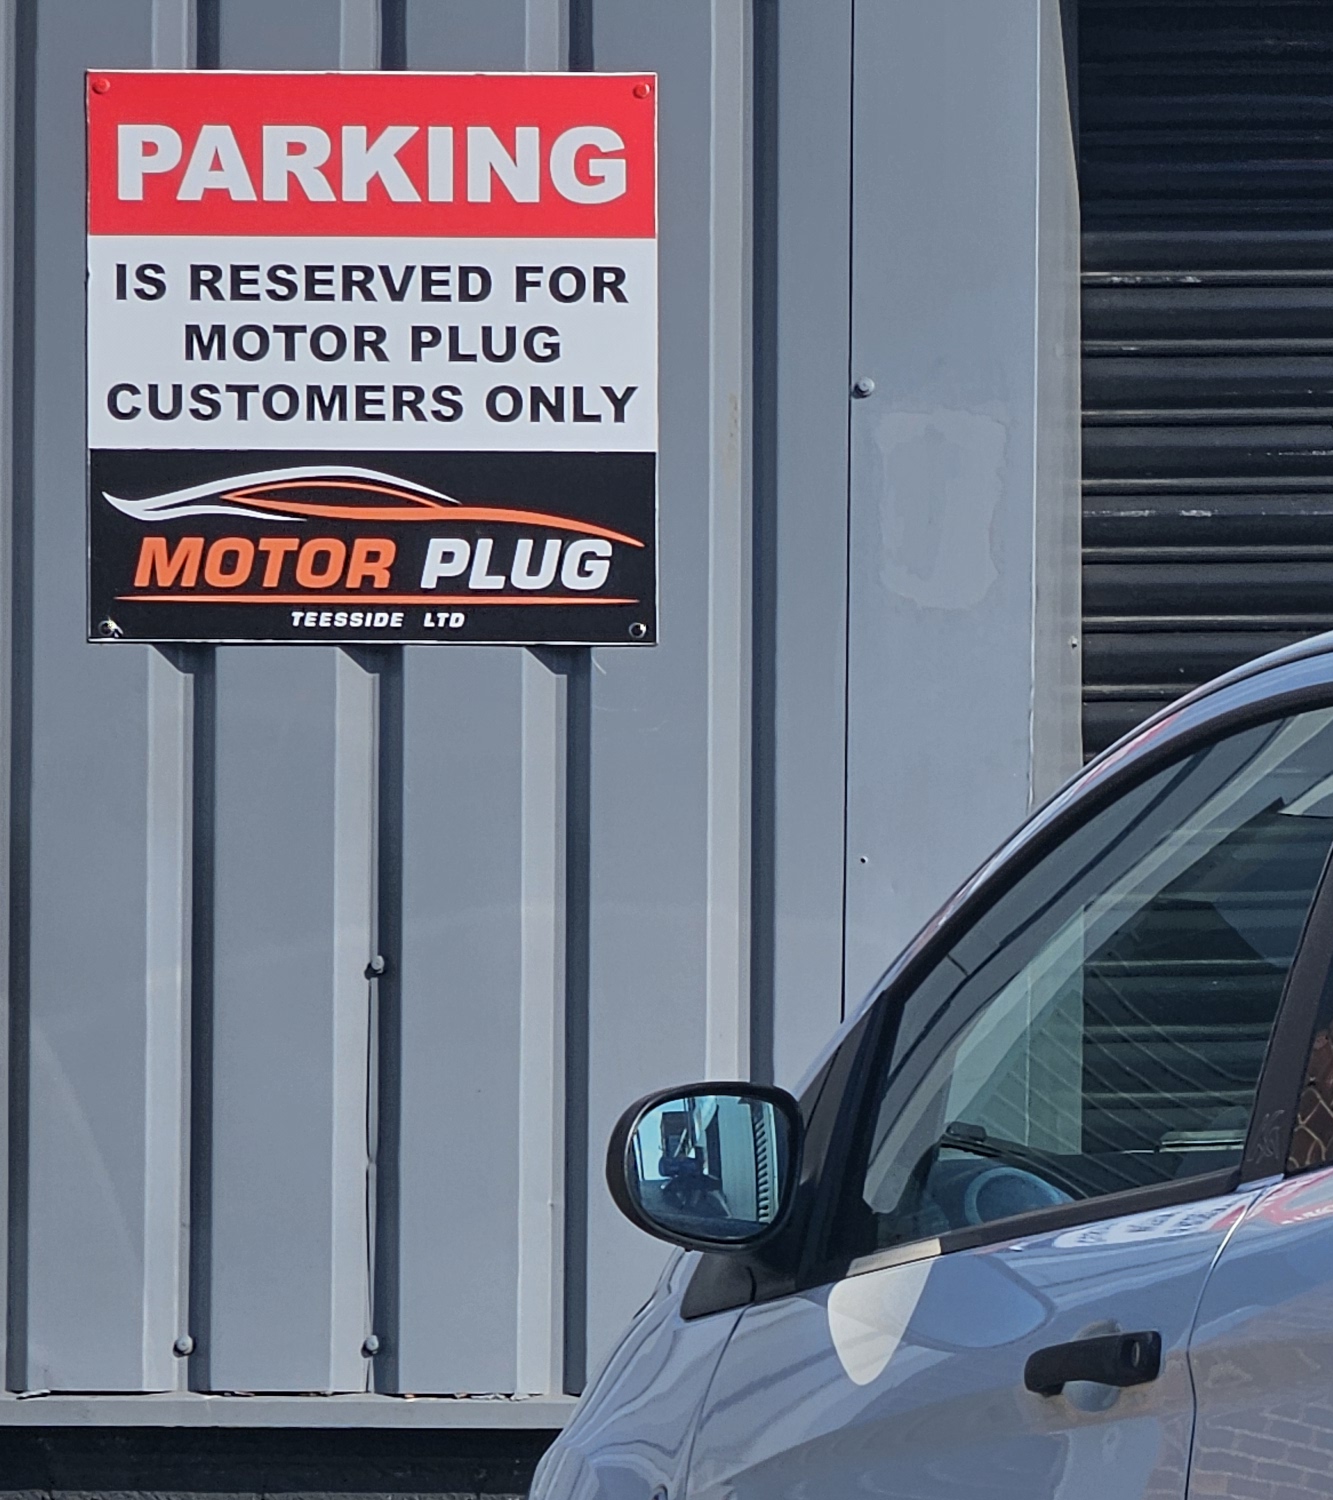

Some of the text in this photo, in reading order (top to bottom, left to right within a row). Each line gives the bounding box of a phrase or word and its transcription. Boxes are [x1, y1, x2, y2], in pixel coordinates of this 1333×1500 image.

[116, 124, 628, 204] PARKING
[114, 263, 630, 304] IS RESERVED FOR
[184, 323, 562, 363] MOTOR PLUG
[106, 383, 639, 424] CUSTOMERS ONLY
[133, 536, 613, 590] MOTOR PLUG
[290, 611, 465, 629] TEESSIDE LTD
